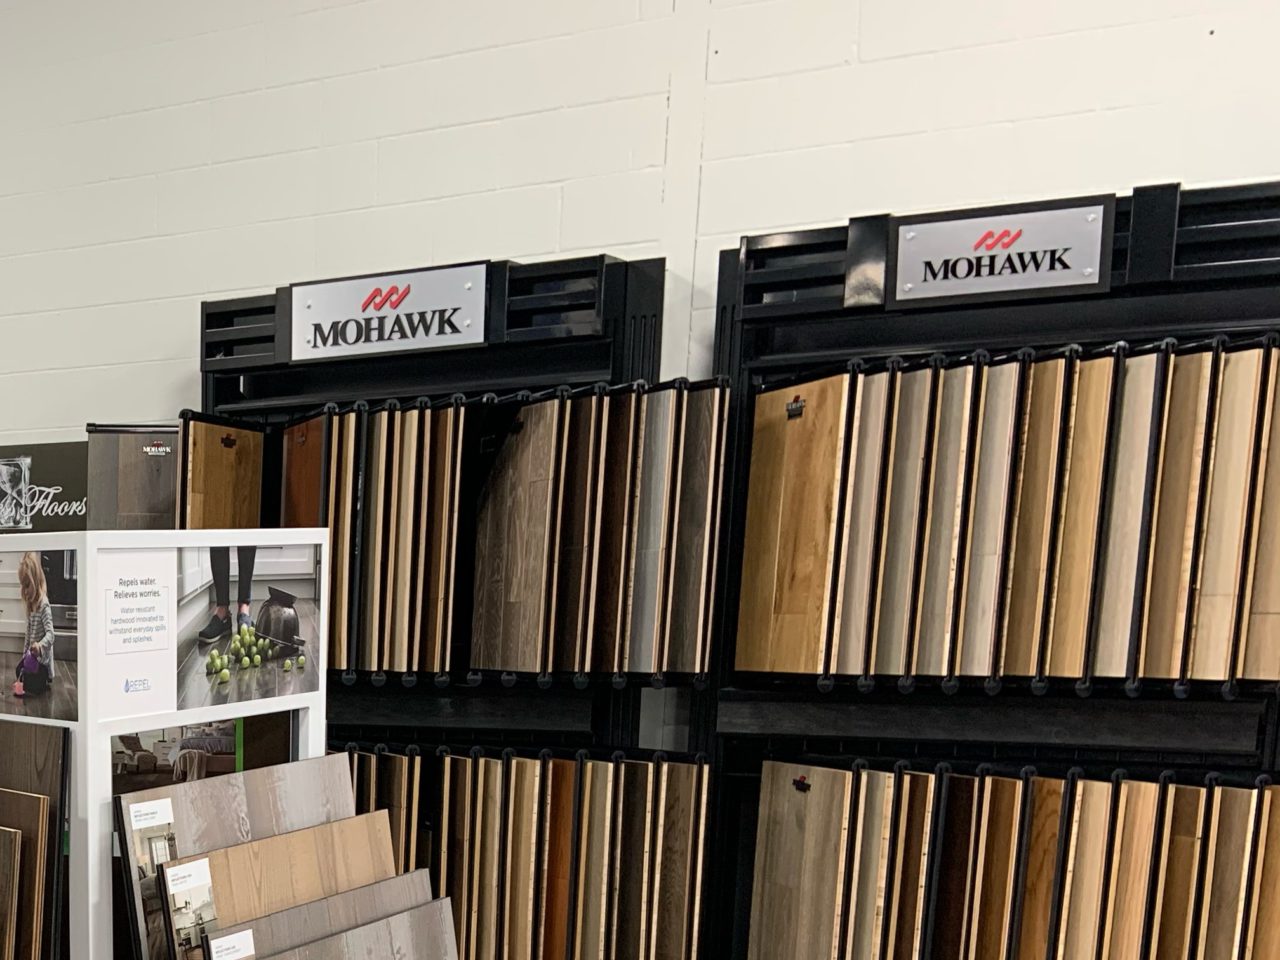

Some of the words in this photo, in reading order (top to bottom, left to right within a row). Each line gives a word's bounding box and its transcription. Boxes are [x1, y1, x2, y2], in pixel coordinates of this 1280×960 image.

[922, 248, 1072, 283] MOHAWK
[311, 307, 462, 348] MOHAWK
[21, 485, 86, 518] Floors
[118, 577, 138, 587] Repels
[139, 577, 157, 586] water.
[113, 590, 138, 599] Relieves
[139, 589, 160, 598] worries.
[130, 678, 151, 689] REPEL
